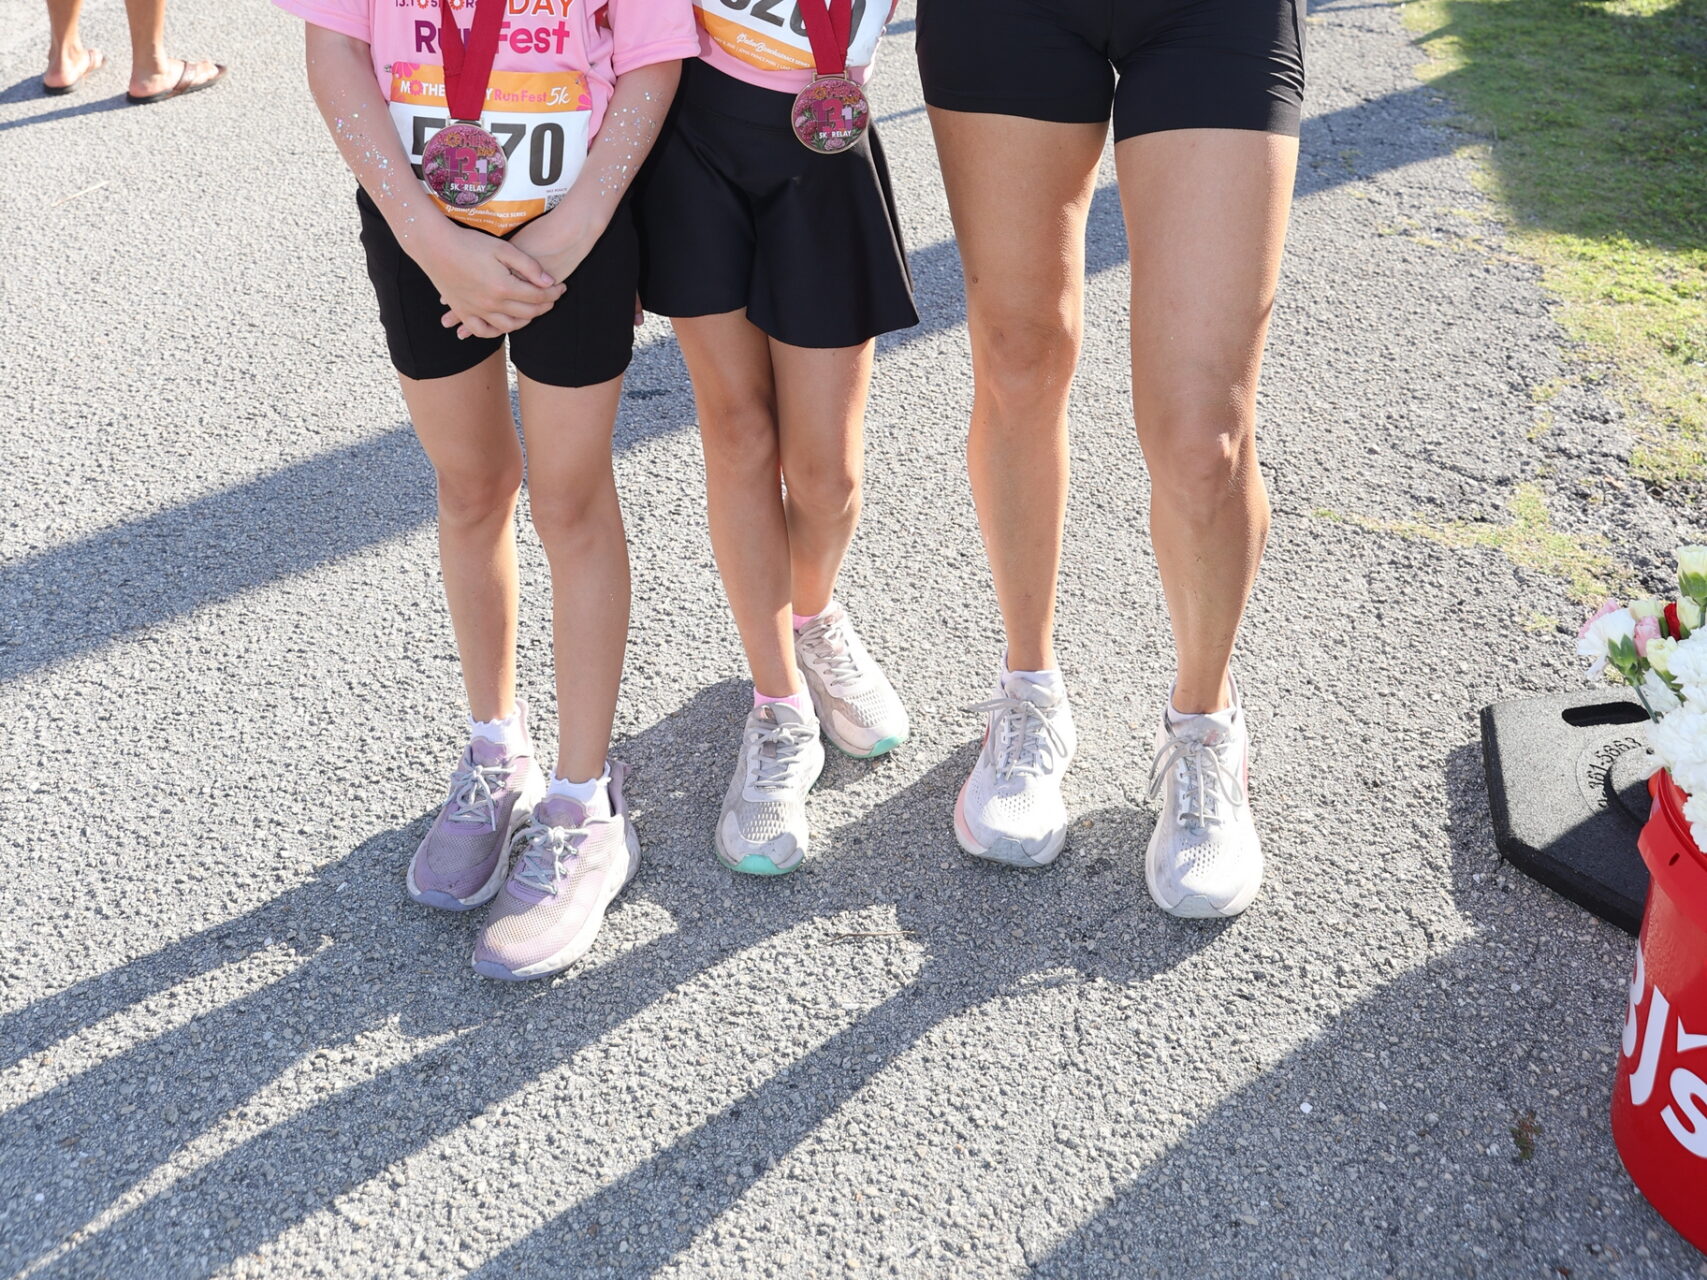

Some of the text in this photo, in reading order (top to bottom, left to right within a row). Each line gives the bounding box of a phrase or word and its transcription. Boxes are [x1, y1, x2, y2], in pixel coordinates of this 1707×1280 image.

[831, 130, 852, 138] RELAY
[411, 116, 565, 187] 570
[463, 183, 487, 192] RELAY
